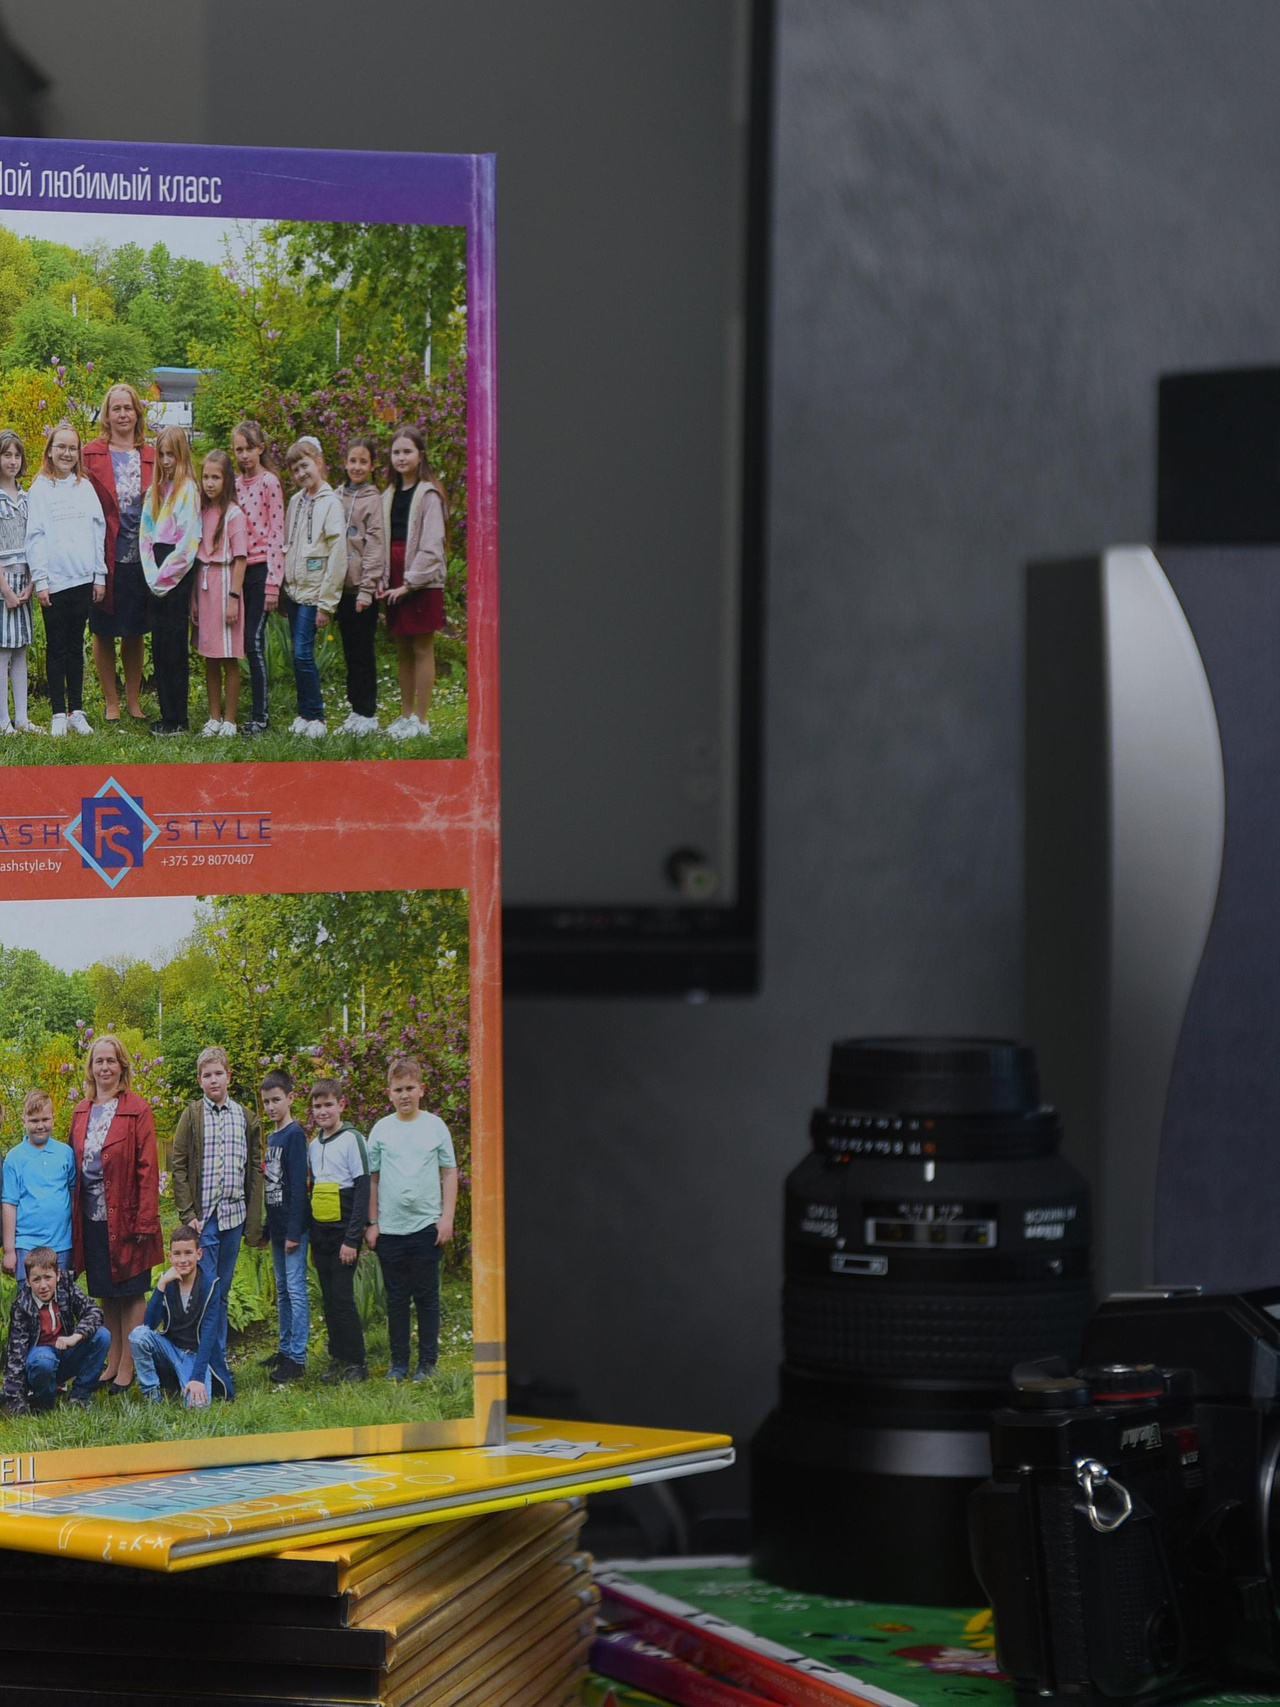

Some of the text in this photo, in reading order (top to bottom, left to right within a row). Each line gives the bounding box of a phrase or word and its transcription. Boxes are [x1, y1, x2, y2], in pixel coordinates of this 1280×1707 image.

[39, 164, 152, 202] любимый
[158, 174, 222, 204] класс
[166, 818, 271, 841] STYLE
[161, 853, 255, 868] +375 29 8070407
